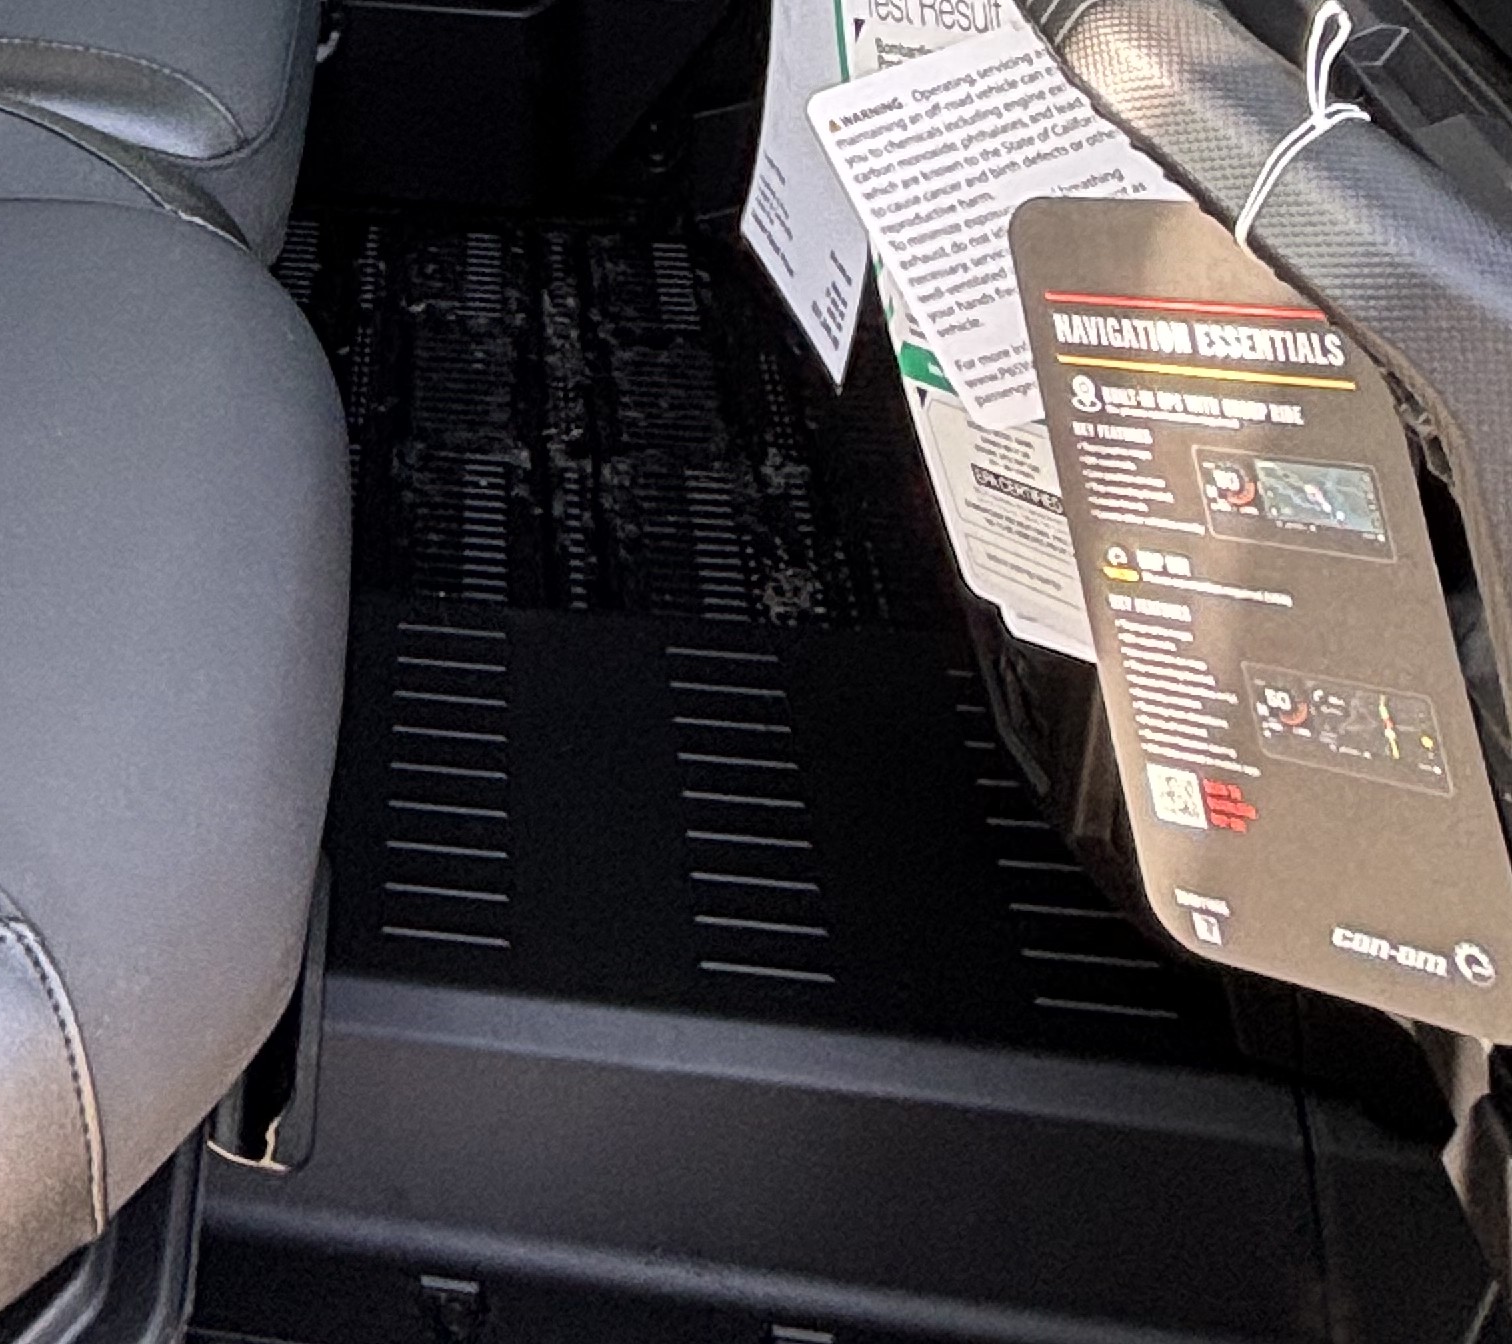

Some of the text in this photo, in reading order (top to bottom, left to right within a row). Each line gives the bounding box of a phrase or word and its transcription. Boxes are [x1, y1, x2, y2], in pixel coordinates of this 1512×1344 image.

[975, 78, 1019, 100] vehicle
[1020, 70, 1044, 85] can
[845, 154, 869, 169] you
[884, 126, 944, 153] chemicals
[943, 106, 1003, 132] including
[1003, 90, 1047, 111] engine
[853, 163, 896, 183] carbon
[1028, 104, 1054, 124] and
[863, 180, 899, 201] which
[901, 175, 920, 190] are
[920, 160, 965, 182] known
[963, 156, 980, 167] to
[979, 147, 1002, 162] the
[1000, 135, 1036, 154] State
[1037, 126, 1051, 144] of
[870, 206, 887, 219] to
[887, 195, 922, 214] cause
[922, 181, 963, 201] cancer
[964, 169, 990, 188] and
[988, 160, 1022, 179] birth
[1022, 146, 1070, 168] defects
[1069, 139, 1085, 152] or
[907, 222, 962, 247] minimize
[950, 240, 968, 254] do
[968, 233, 991, 248] not
[926, 306, 956, 324] your
[955, 292, 996, 311] hands
[977, 349, 1010, 365] more
[1053, 313, 1346, 367] NAVIGATION ESSENTIALS
